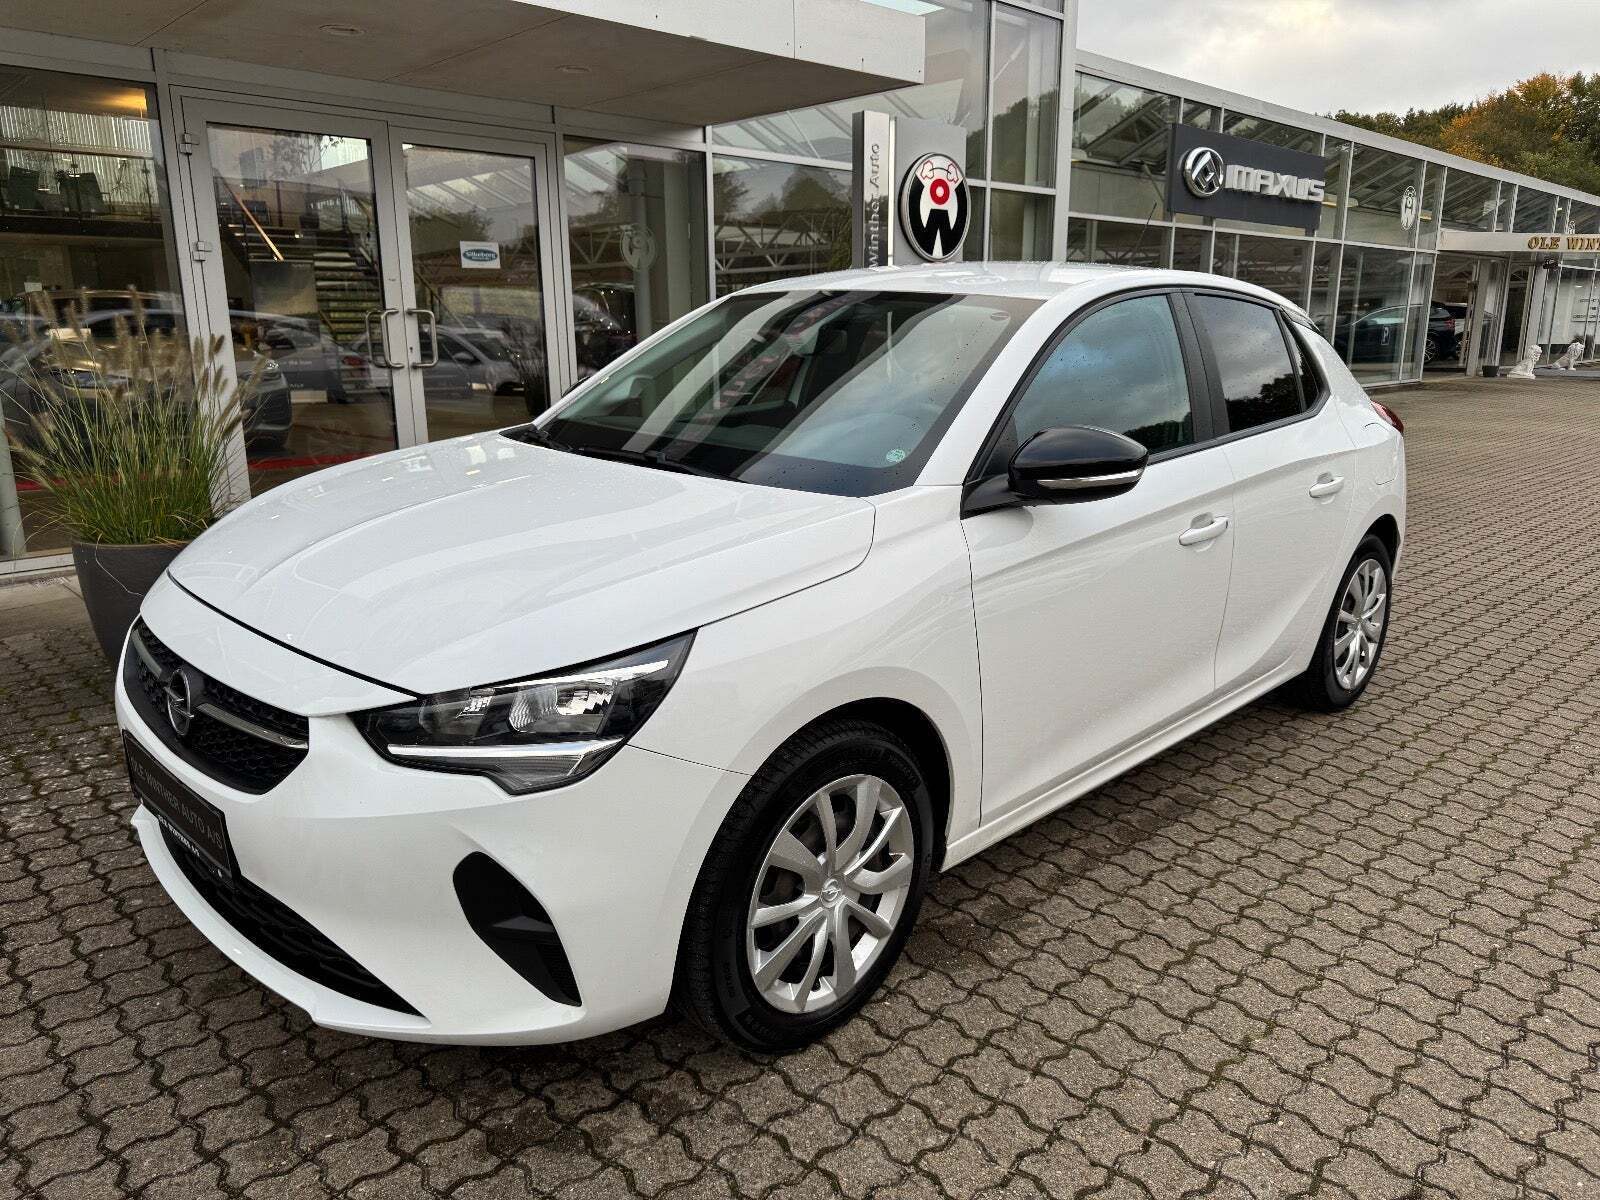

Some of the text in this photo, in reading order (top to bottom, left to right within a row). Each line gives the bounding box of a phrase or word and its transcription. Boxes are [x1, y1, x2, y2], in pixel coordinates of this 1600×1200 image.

[869, 144, 880, 189] Auto
[1225, 165, 1325, 202] MAXUS
[1528, 236, 1560, 249] OLE
[181, 802, 205, 834] AUTO
[207, 825, 223, 849] A/S
